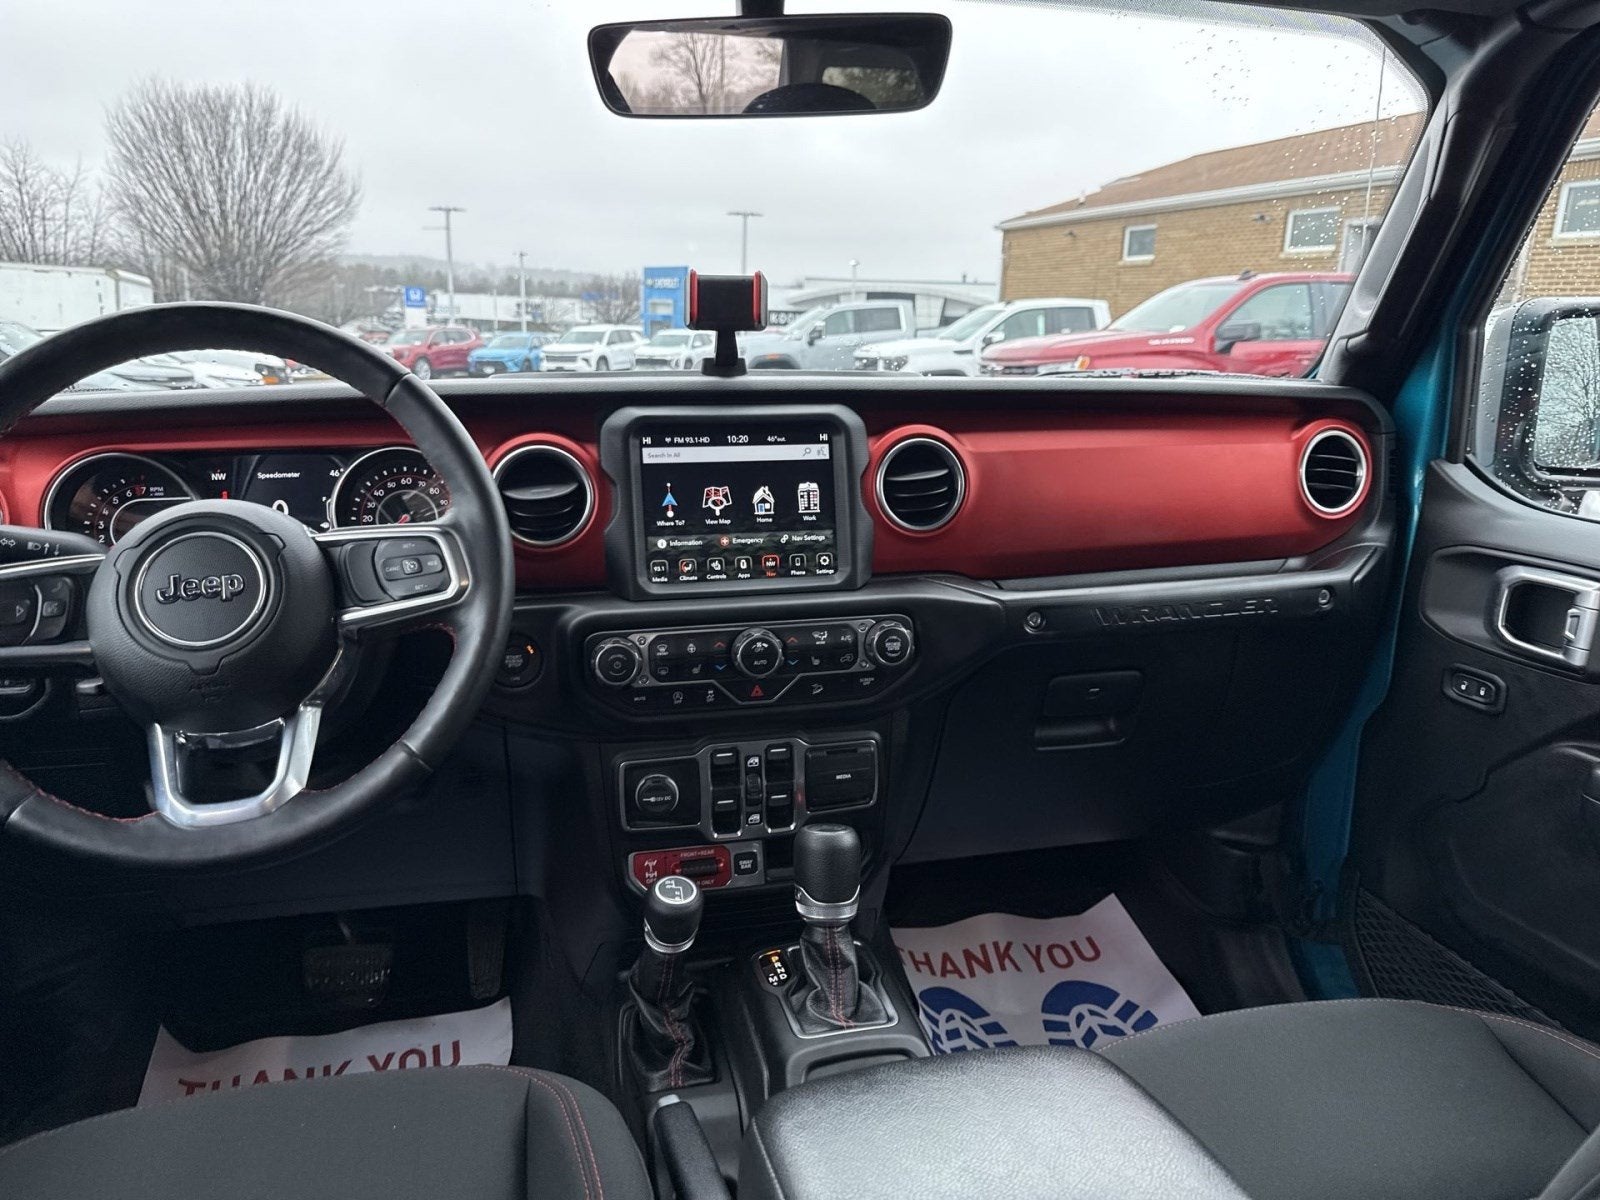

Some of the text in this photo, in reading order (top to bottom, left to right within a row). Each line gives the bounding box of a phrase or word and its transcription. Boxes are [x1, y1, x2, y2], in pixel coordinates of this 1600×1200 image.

[642, 436, 652, 444] HI
[727, 434, 749, 443] 10:20
[819, 433, 828, 441] HI
[211, 472, 227, 481] NW
[257, 471, 300, 479] Speedometer
[401, 477, 412, 485] 60
[126, 489, 133, 497] 6
[140, 486, 147, 495] 7
[373, 489, 385, 497] 40
[112, 496, 119, 505] 5
[102, 507, 109, 516] 4
[362, 515, 374, 523] 20
[718, 518, 732, 526] Map
[98, 520, 105, 530] 3
[98, 534, 105, 544] 2
[732, 537, 764, 545] Emergency
[804, 534, 826, 542] Settings
[669, 539, 703, 547] Information
[156, 573, 246, 604] Jeep
[899, 935, 1102, 980] HANK YOU
[366, 1039, 462, 1073] YOU
